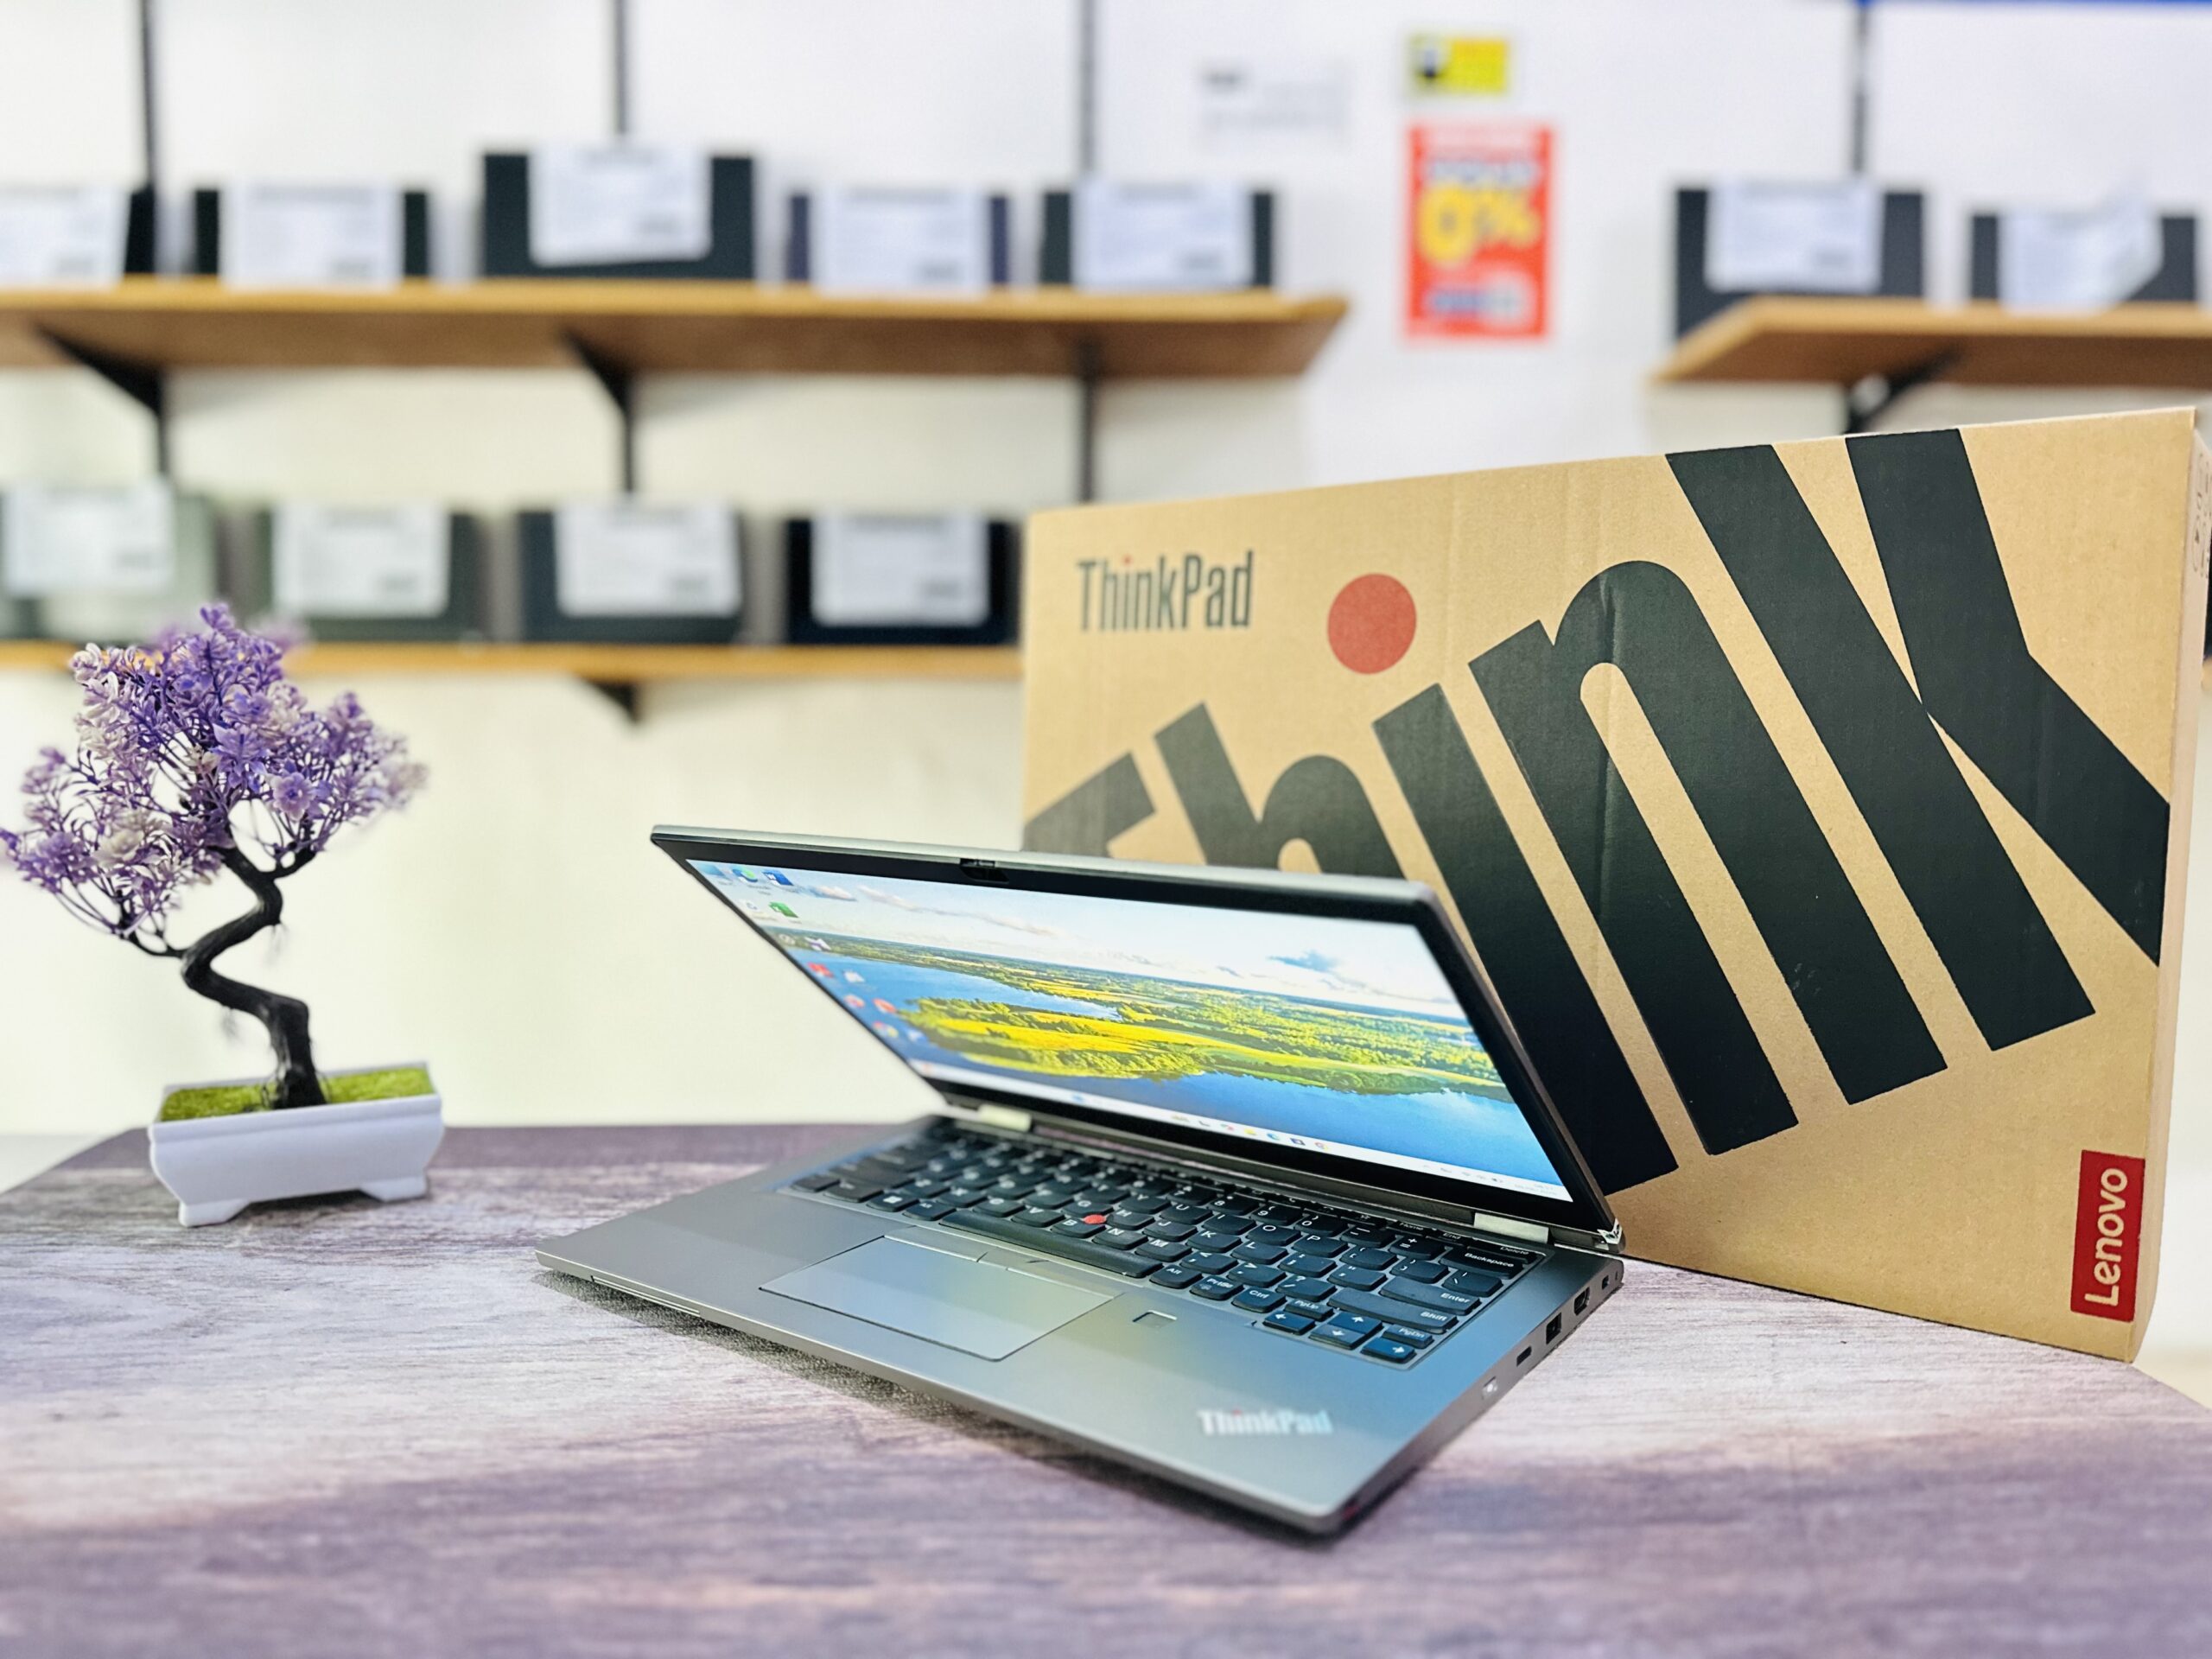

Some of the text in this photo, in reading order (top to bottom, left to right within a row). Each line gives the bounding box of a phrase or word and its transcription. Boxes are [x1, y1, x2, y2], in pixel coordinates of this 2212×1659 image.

[1076, 549, 1254, 632] ThinkPad
[1024, 428, 2170, 1193] ink
[2084, 1168, 2128, 1307] Lenovo
[1500, 1246, 1529, 1255] Delete
[1465, 1253, 1515, 1267] Backspace
[1440, 1293, 1471, 1302] Enter
[1294, 1300, 1319, 1309] PgUp
[1420, 1312, 1447, 1321] Shift
[1399, 1327, 1426, 1338] PgDn
[1197, 1409, 1333, 1436] ThinkPad
